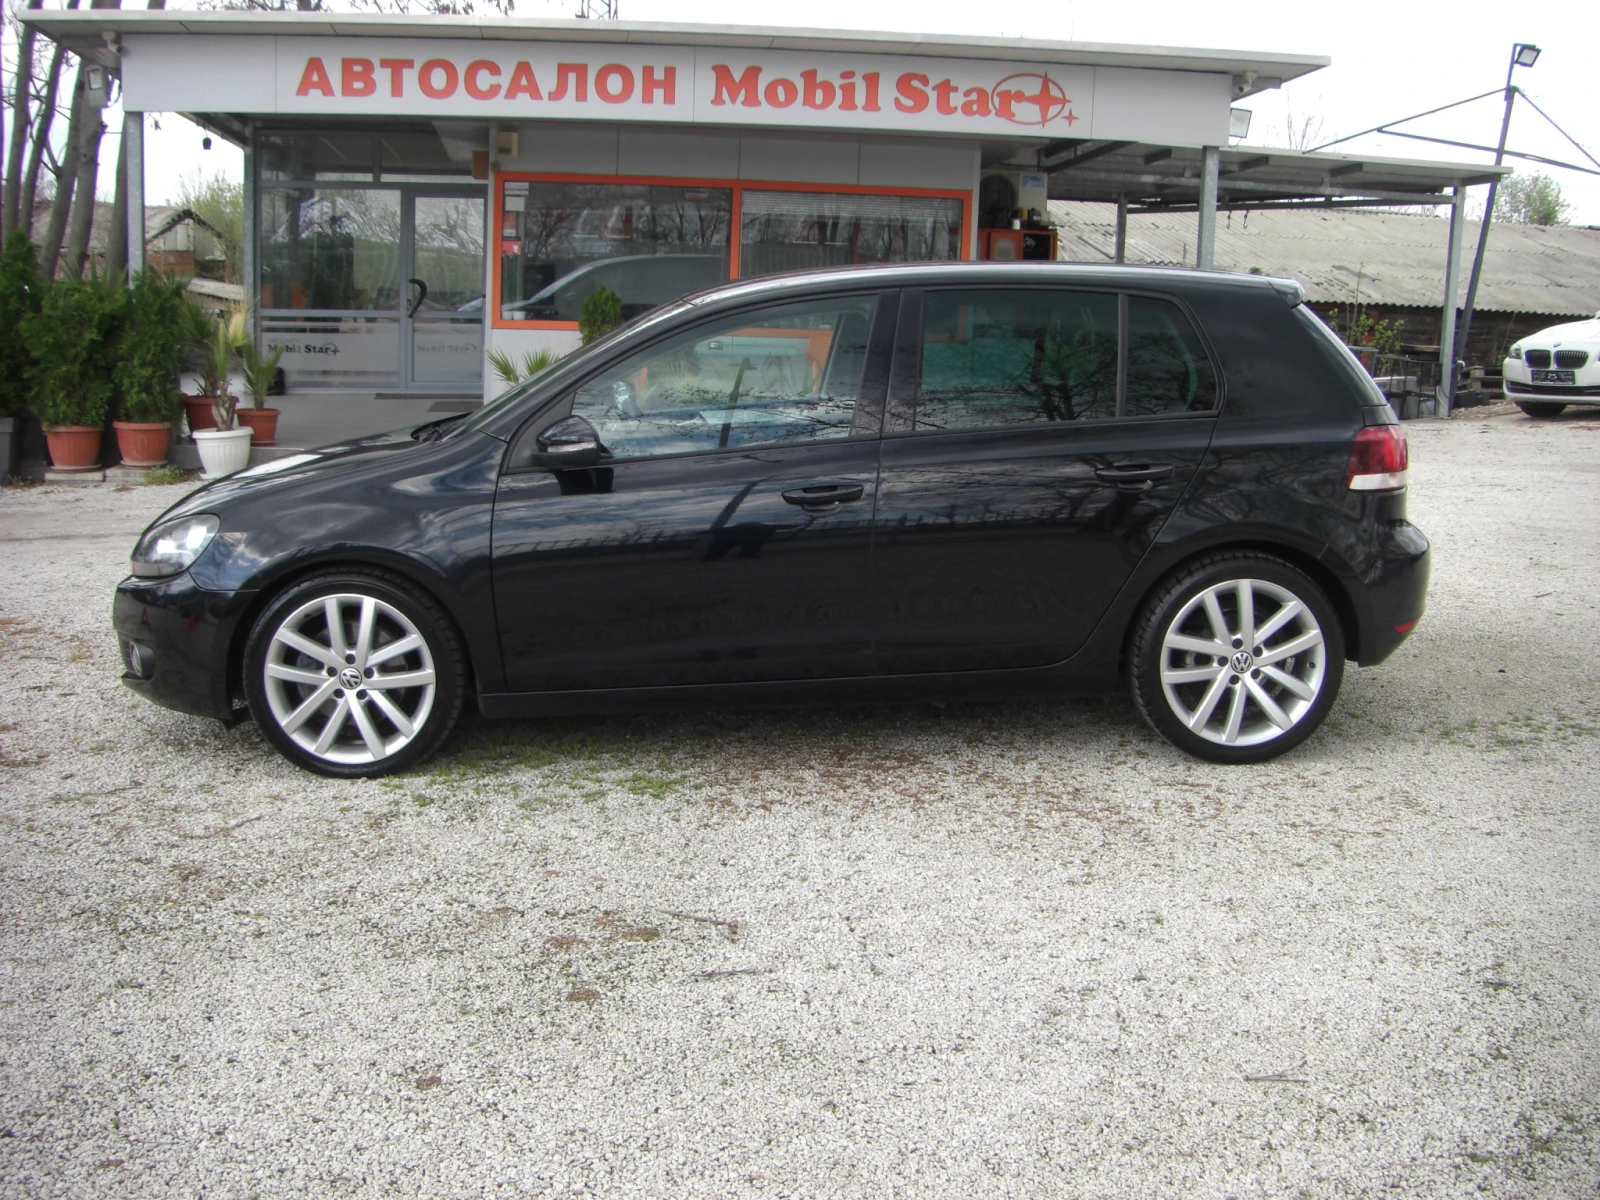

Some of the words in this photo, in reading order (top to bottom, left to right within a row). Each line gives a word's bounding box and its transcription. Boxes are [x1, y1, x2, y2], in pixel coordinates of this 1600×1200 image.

[296, 57, 677, 105] АВТОСАЛОН
[710, 64, 882, 113] Mobil
[893, 72, 1025, 119] Star
[268, 344, 301, 353] Mbil
[304, 344, 331, 354] Star
[1231, 651, 1253, 674] VW
